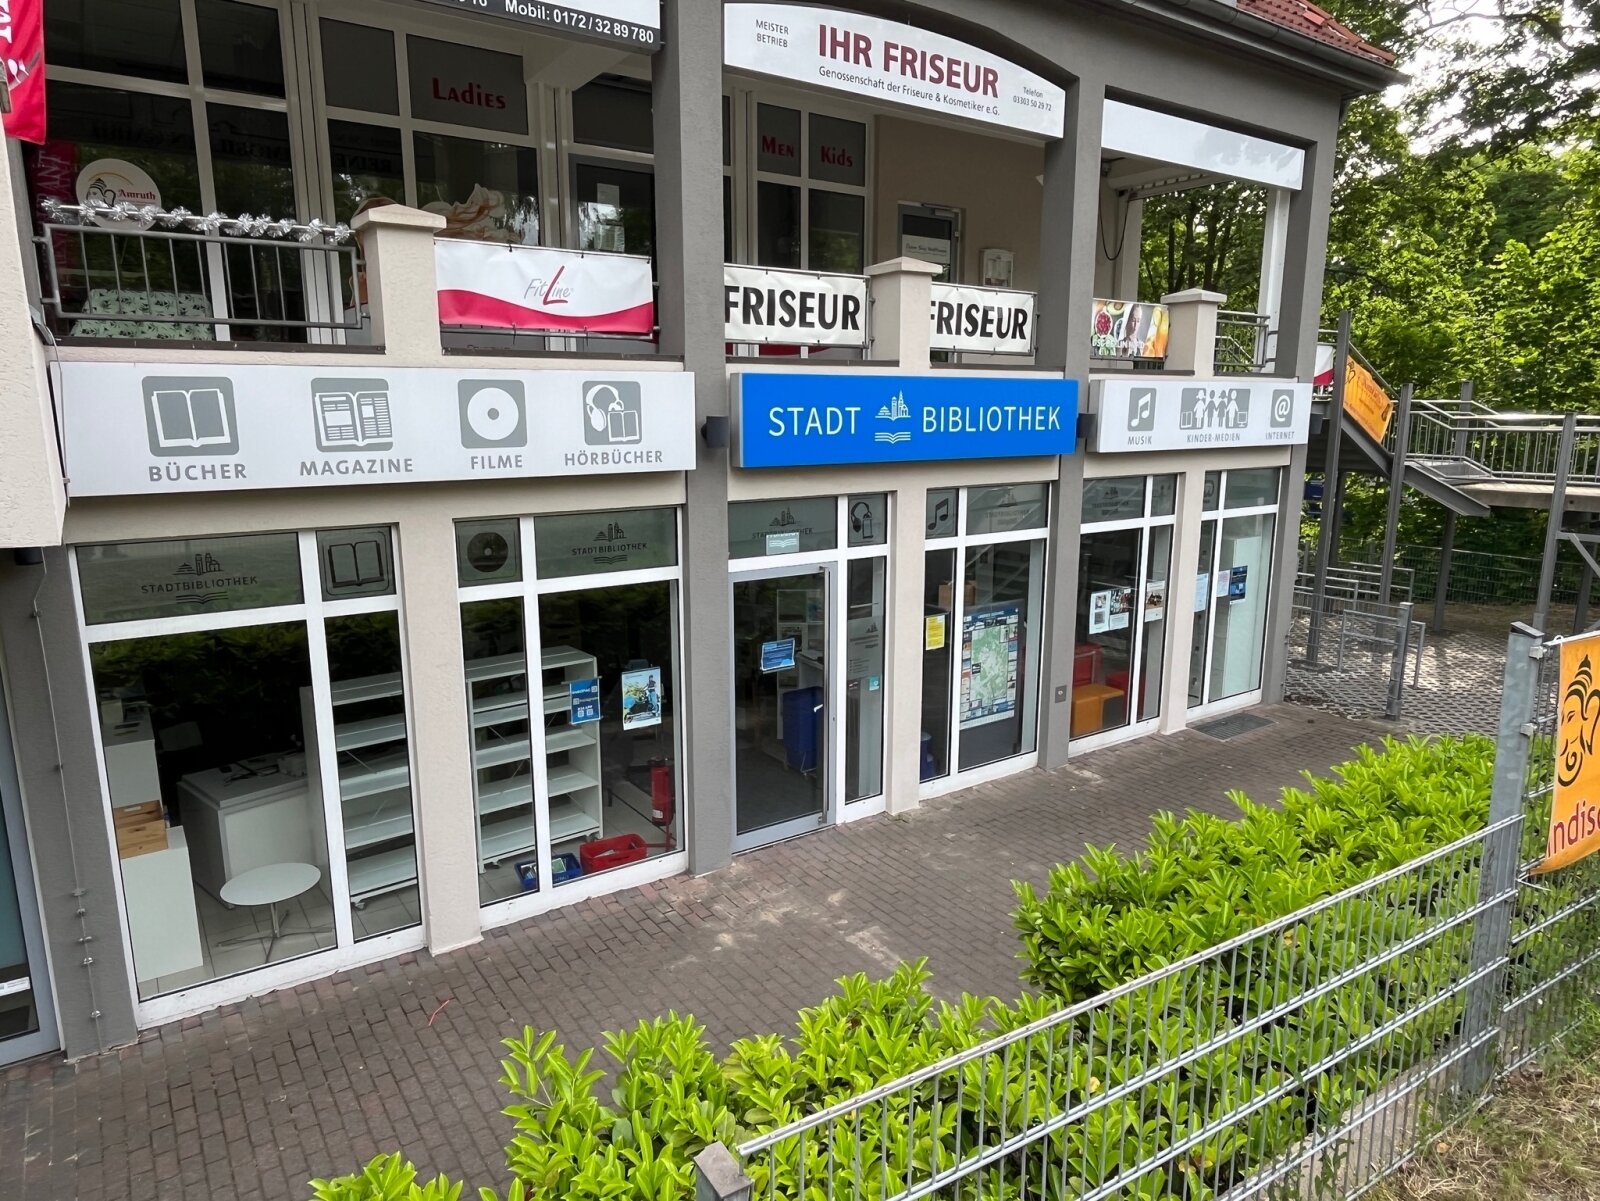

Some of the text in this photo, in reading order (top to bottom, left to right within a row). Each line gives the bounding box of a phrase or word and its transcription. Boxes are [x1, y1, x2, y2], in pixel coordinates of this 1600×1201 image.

[505, 0, 550, 20] Mobil:
[553, 8, 587, 29] 0172
[595, 18, 611, 35] 32
[613, 22, 629, 38] 89
[631, 26, 654, 44] 780
[755, 19, 789, 35] MEISTER
[756, 33, 788, 48] BETRIEB
[819, 23, 999, 98] IHR FRISEUR
[818, 65, 885, 90] Genossenschaft
[886, 82, 900, 93] der
[902, 84, 933, 101] Friseure
[935, 92, 941, 102] &
[943, 94, 984, 112] Kosmetiker
[1023, 86, 1044, 98] Telefon
[1030, 99, 1038, 108] 50
[820, 146, 853, 168] Kids
[118, 188, 156, 200] Amruth
[725, 284, 861, 331] FRISEUR
[768, 405, 1061, 438] STADT BIBLIOTHEK
[1127, 435, 1152, 446] MUSIK
[1186, 433, 1241, 444] KINDER-MEDIEN
[1265, 431, 1295, 440] INTERNET
[470, 454, 523, 470] FILME
[564, 449, 663, 467] HÖRBÜCHER
[148, 461, 247, 482] BÜCHER
[300, 457, 413, 477] MAGAZINE
[571, 543, 647, 556] STADTBIBLIOTHEK
[141, 575, 258, 594] STADTBIBLIOTHEK
